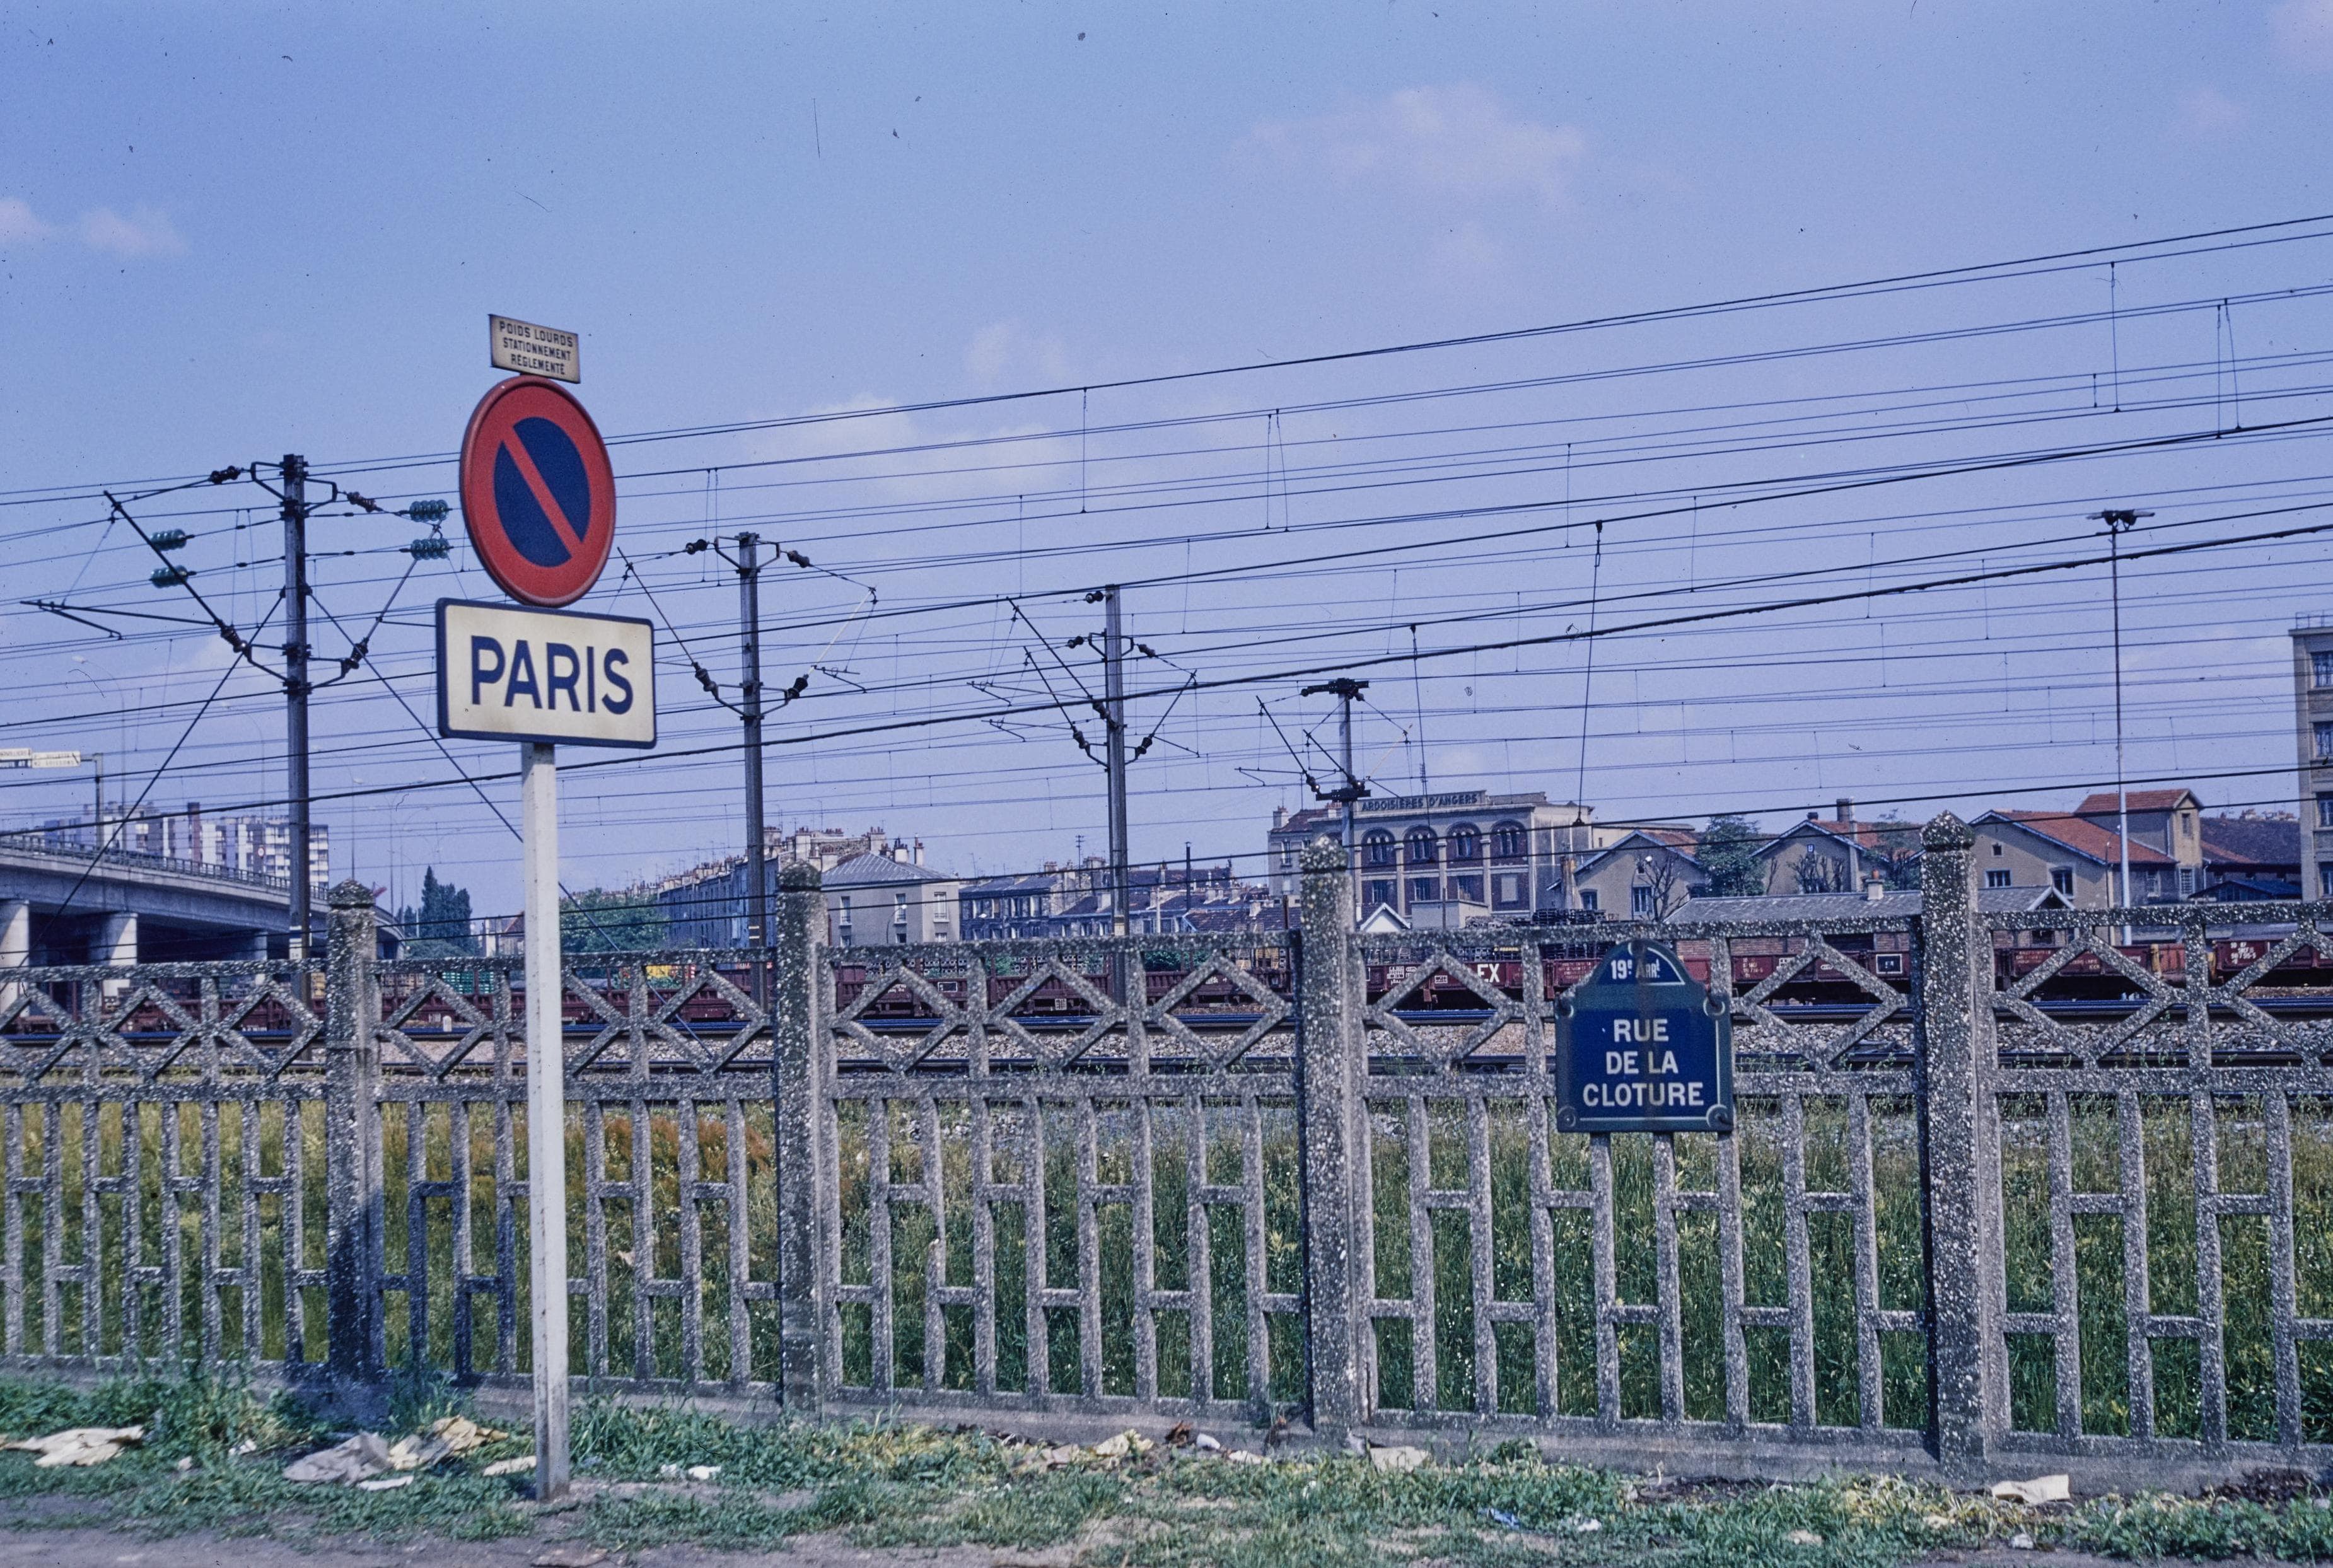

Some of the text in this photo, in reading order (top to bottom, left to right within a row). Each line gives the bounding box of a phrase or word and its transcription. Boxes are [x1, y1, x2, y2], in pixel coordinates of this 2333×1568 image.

[499, 320, 573, 347] POIDS LOURDS
[503, 337, 571, 361] STATIONNEMENT
[471, 635, 634, 715] PARIS
[1429, 794, 1477, 807] D'ANGERS
[1613, 1019, 1669, 1042] RUE
[1605, 1050, 1679, 1074] DE LA
[1583, 1082, 1704, 1106] CLOTURE
